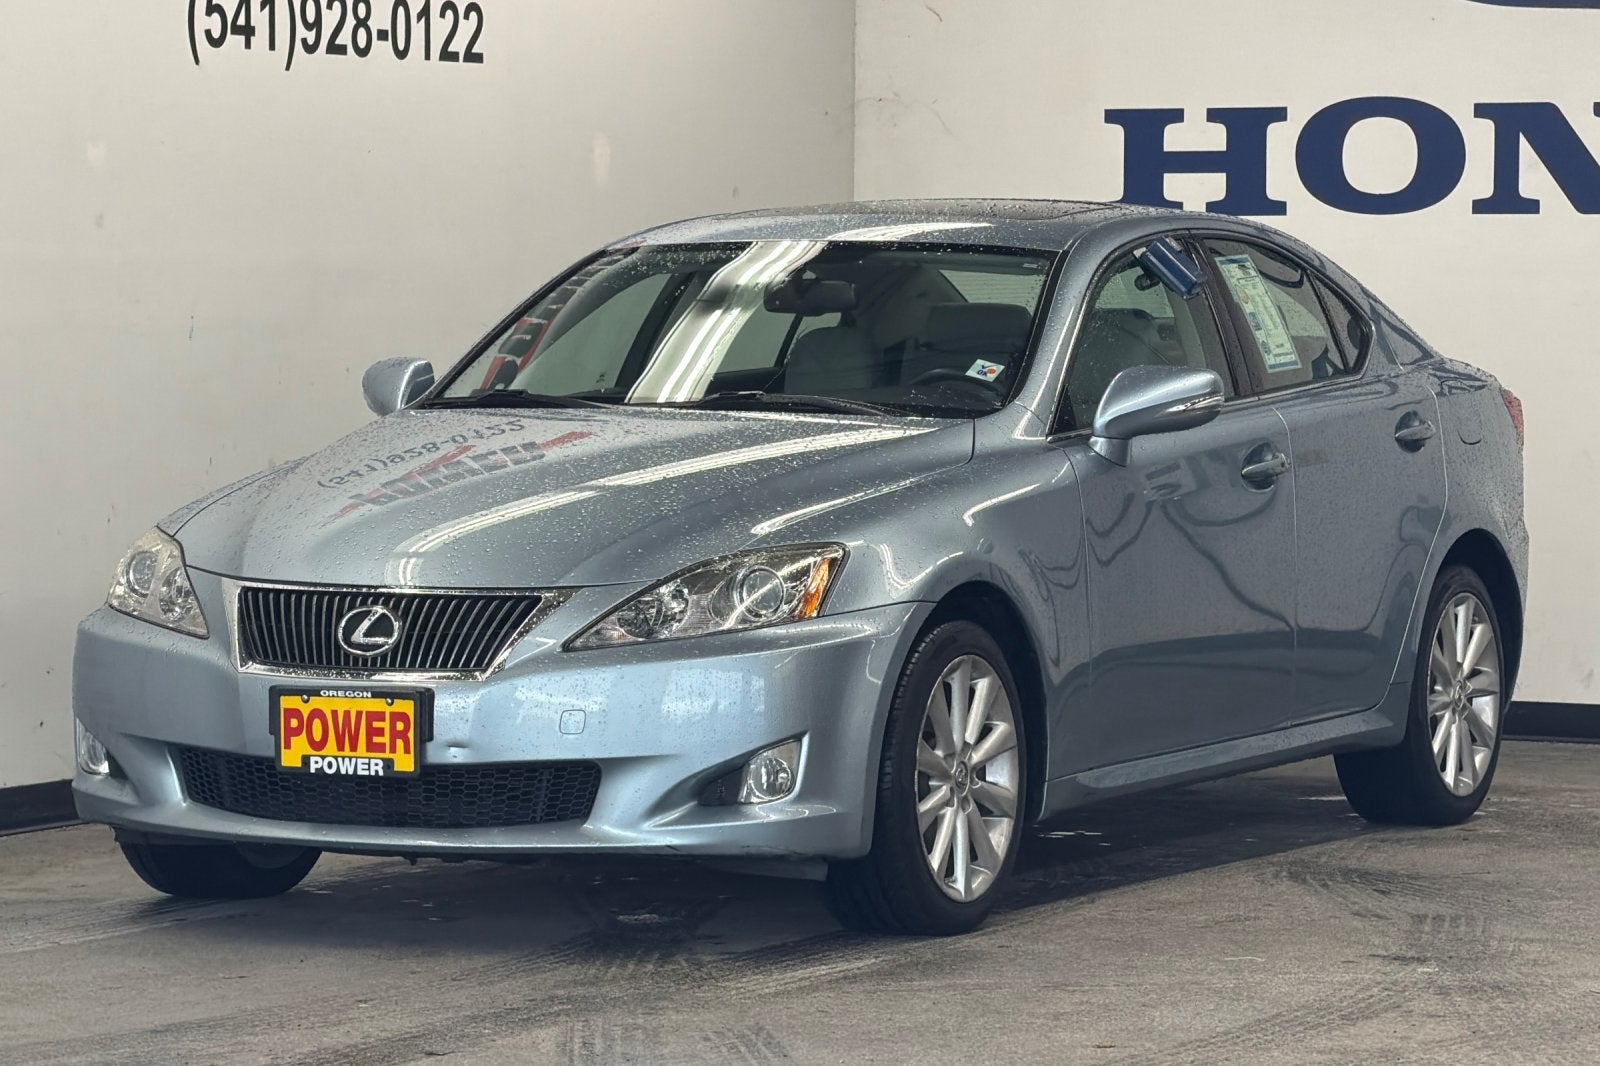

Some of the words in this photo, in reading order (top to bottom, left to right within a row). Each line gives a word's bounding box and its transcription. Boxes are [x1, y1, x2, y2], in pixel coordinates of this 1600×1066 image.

[187, 0, 484, 71] (541)928-0122
[319, 689, 372, 698] OREGON
[283, 707, 411, 755] POWER
[309, 755, 384, 776] POWER
